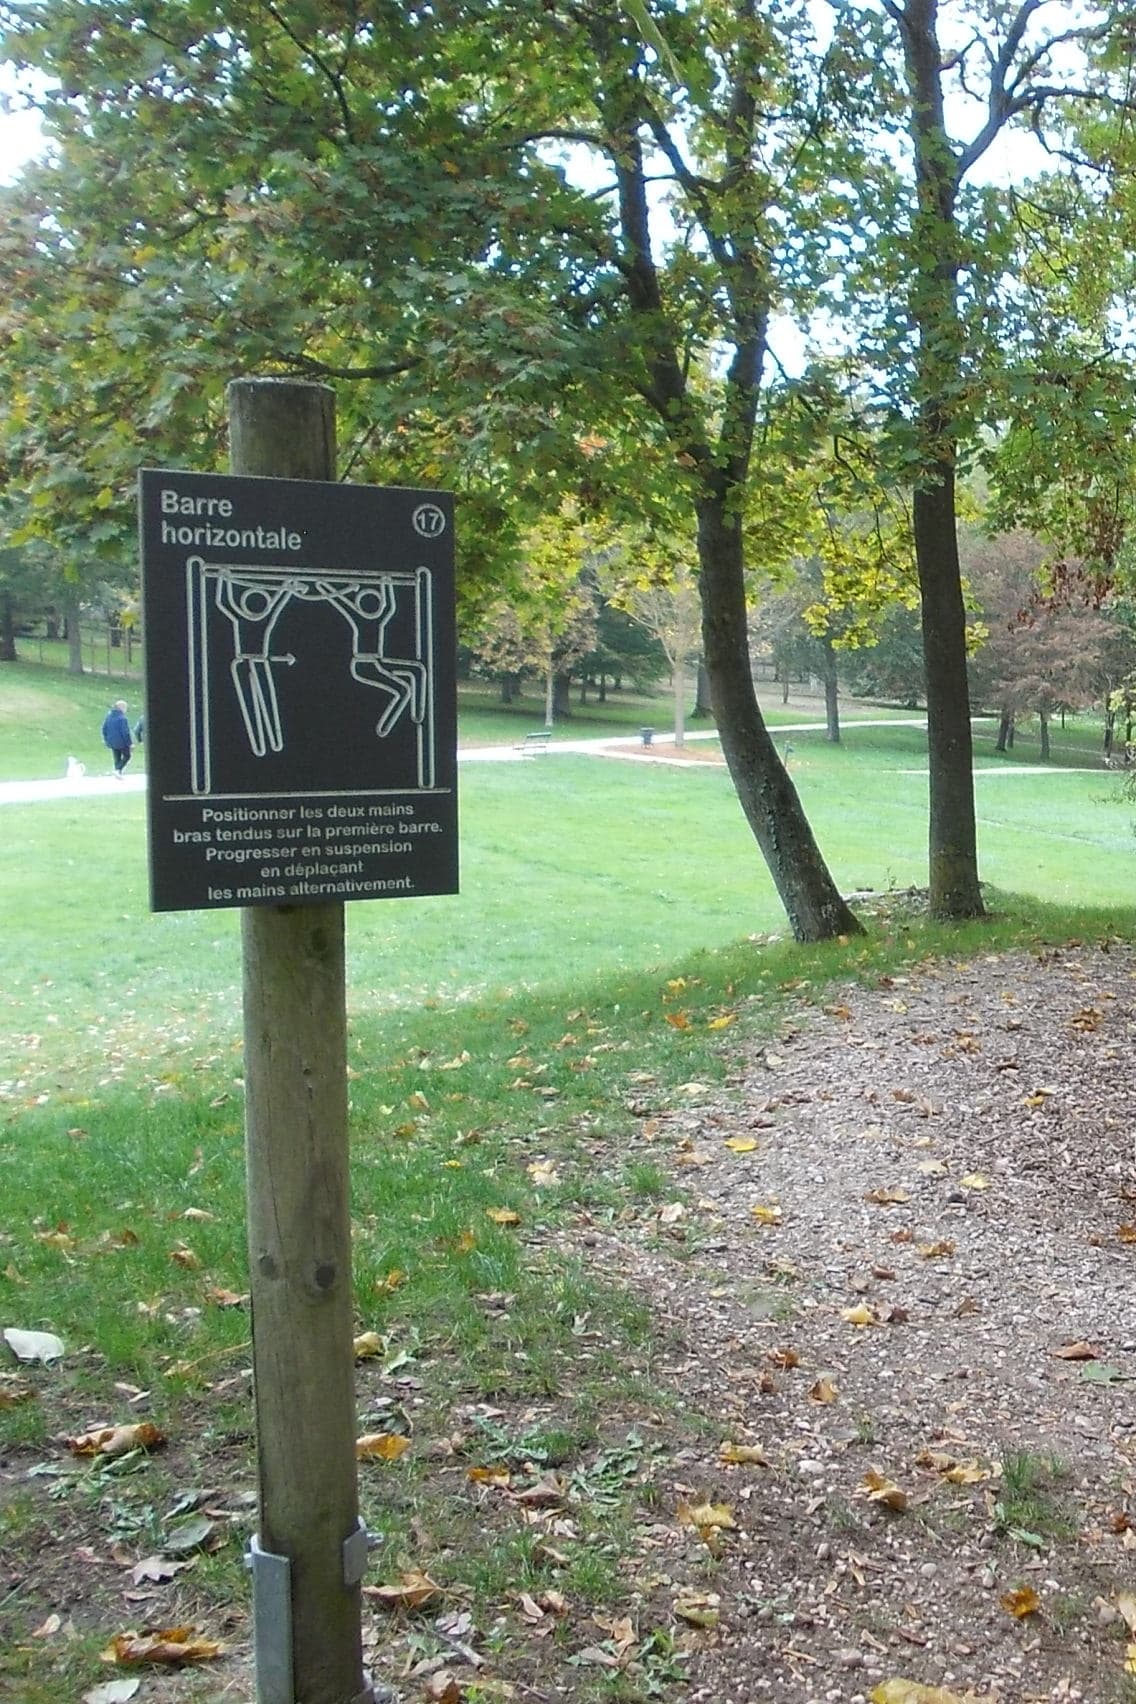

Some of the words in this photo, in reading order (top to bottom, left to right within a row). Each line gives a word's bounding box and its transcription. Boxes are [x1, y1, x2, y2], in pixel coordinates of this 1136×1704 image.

[160, 489, 233, 517] Barre
[417, 511, 440, 531] 17
[161, 521, 302, 550] horizontale
[202, 807, 296, 822] Positionner
[300, 805, 323, 819] les
[327, 804, 365, 818] deux
[369, 803, 414, 817] mains
[173, 829, 211, 843] bras
[216, 827, 272, 841] tendus
[276, 827, 303, 840] sur
[307, 825, 321, 838] la
[325, 822, 395, 840] première
[398, 821, 443, 835] barre.
[205, 846, 297, 863] Progresser
[301, 845, 321, 857] en
[325, 839, 412, 859] suspension
[260, 866, 280, 878] en
[284, 860, 364, 878] déplaçant
[208, 886, 232, 900] les
[237, 883, 285, 898] mains
[290, 876, 415, 895] alternativement.
